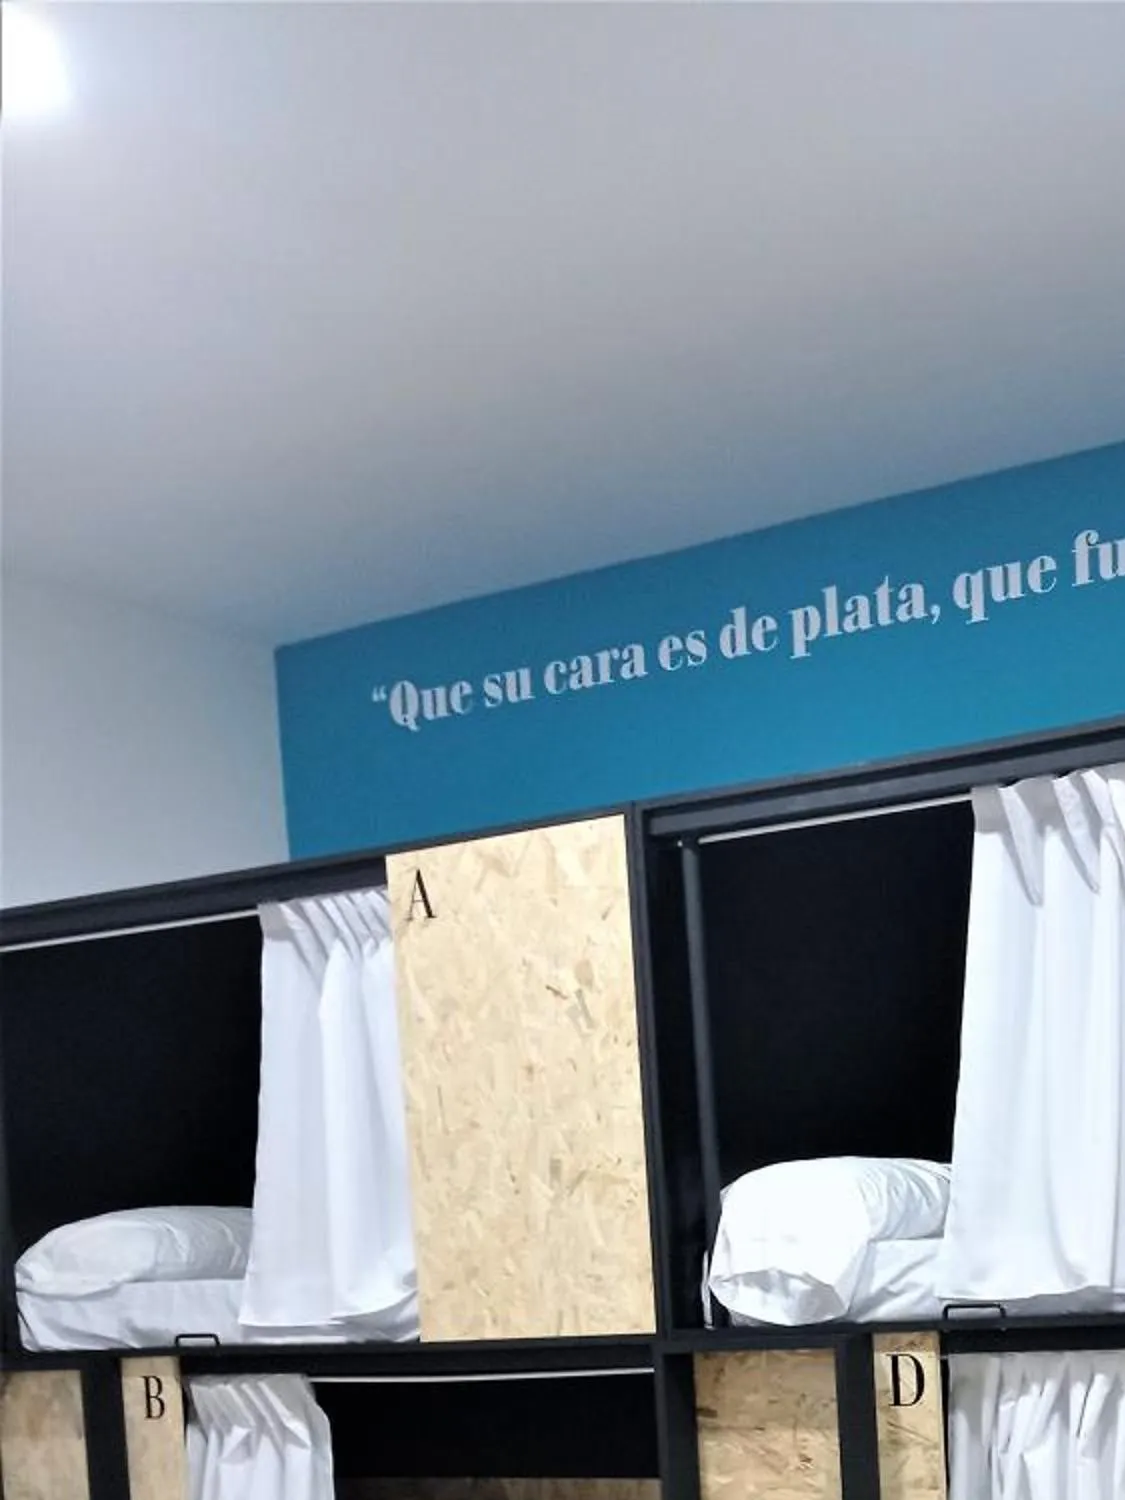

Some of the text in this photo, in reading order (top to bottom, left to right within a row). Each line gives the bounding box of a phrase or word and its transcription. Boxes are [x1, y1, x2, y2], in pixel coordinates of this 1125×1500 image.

[483, 667, 532, 708] su
[544, 643, 648, 695] cara
[658, 629, 708, 671] es
[719, 606, 778, 658] de
[790, 577, 941, 659] plata,
[953, 554, 1057, 623] que
[404, 867, 437, 922] A
[142, 1374, 166, 1420] B
[888, 1353, 924, 1406] D
